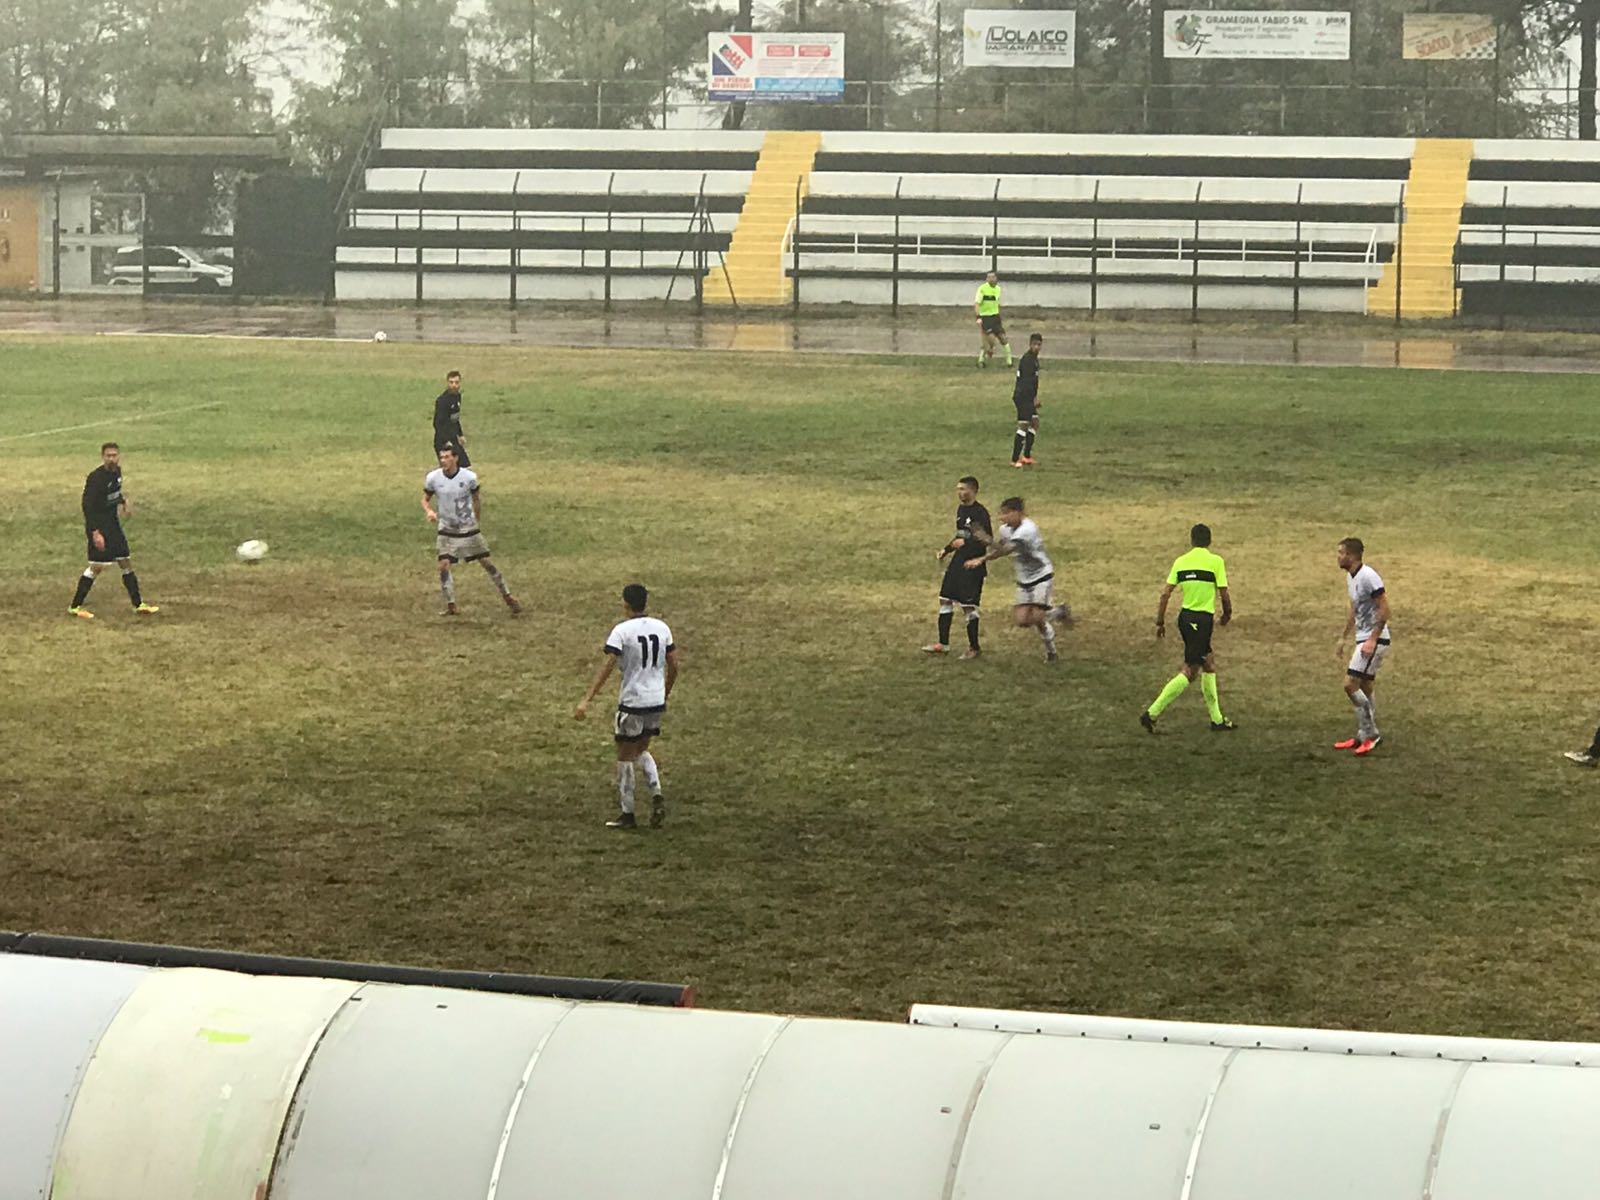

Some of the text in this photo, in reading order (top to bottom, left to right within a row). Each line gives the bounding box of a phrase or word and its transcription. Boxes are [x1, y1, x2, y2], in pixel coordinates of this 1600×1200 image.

[1262, 16, 1290, 25] FABIO
[1292, 16, 1309, 25] SRL
[637, 634, 659, 669] 11
